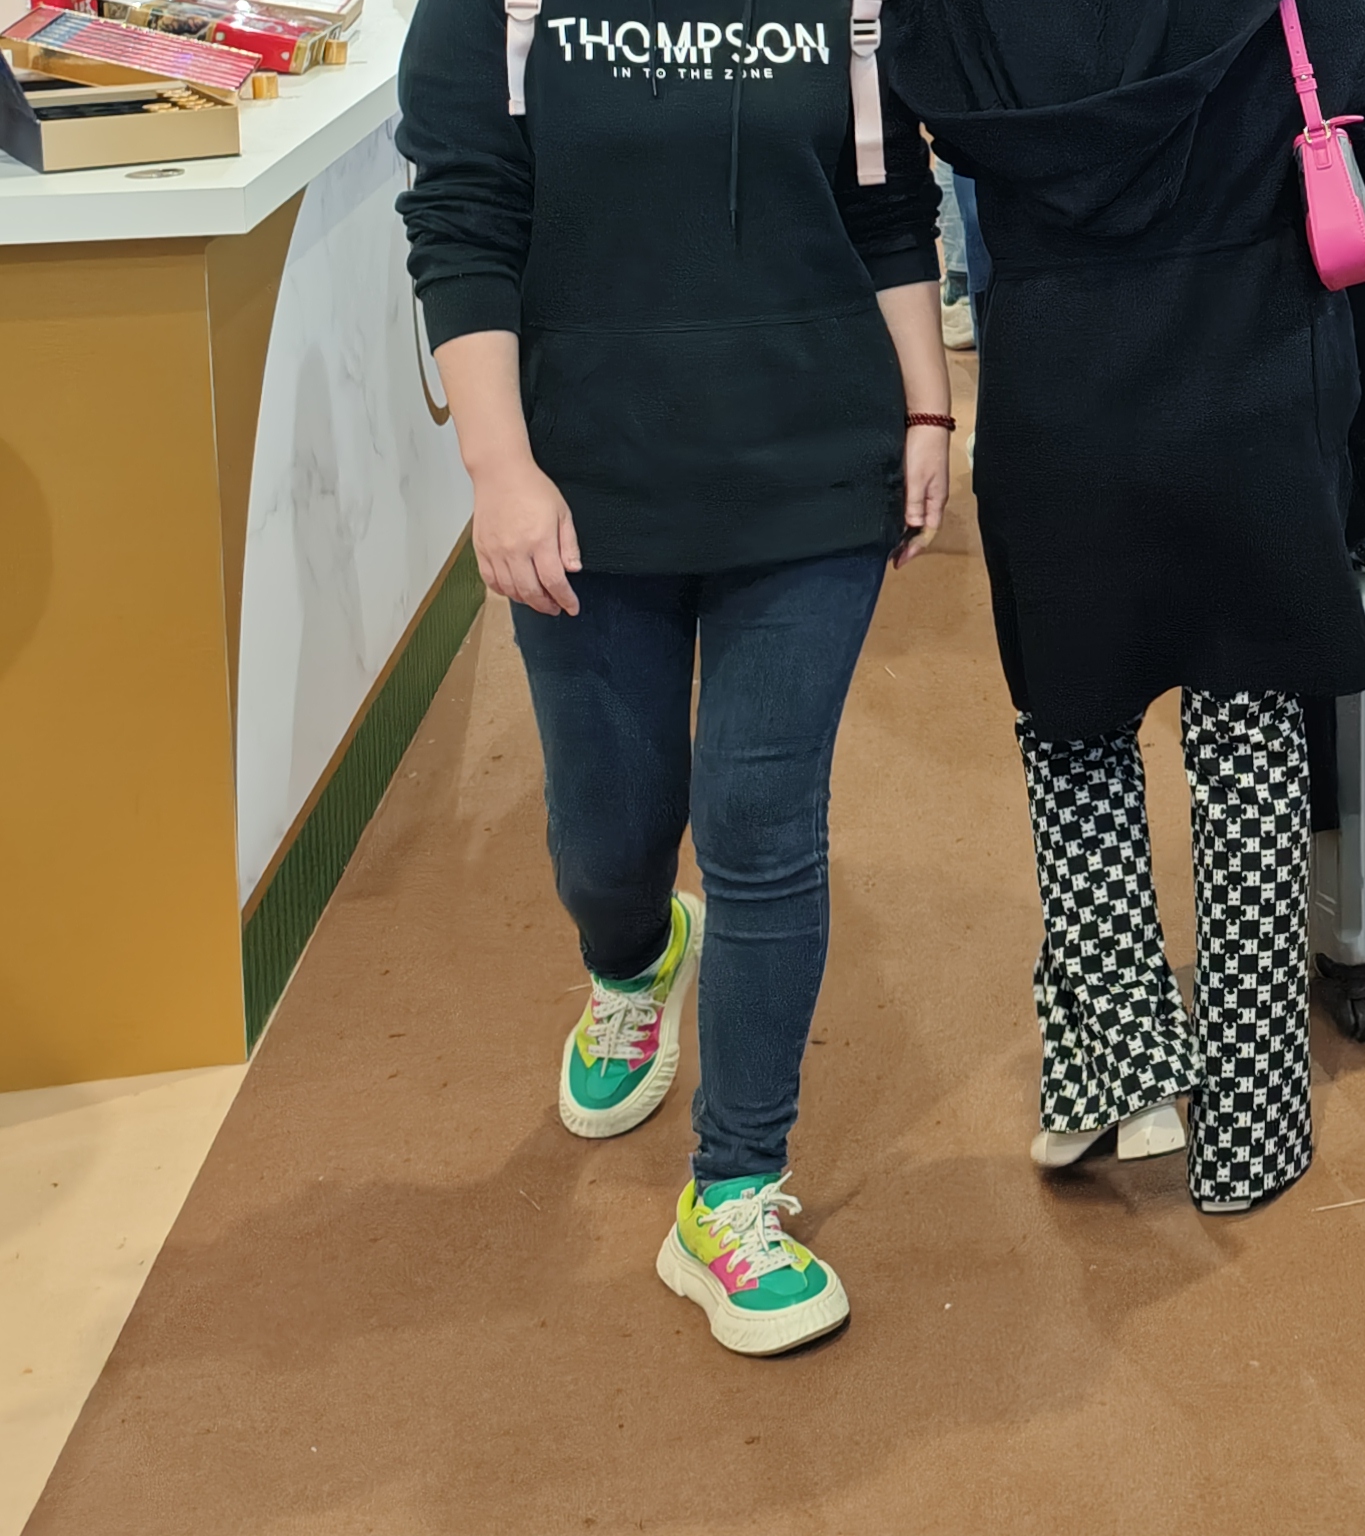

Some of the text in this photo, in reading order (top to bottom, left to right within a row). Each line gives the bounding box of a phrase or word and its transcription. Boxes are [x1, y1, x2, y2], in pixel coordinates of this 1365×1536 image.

[547, 17, 830, 65] THOMPSON
[613, 66, 632, 79] IN
[645, 67, 667, 79] TO
[678, 67, 713, 81] THE
